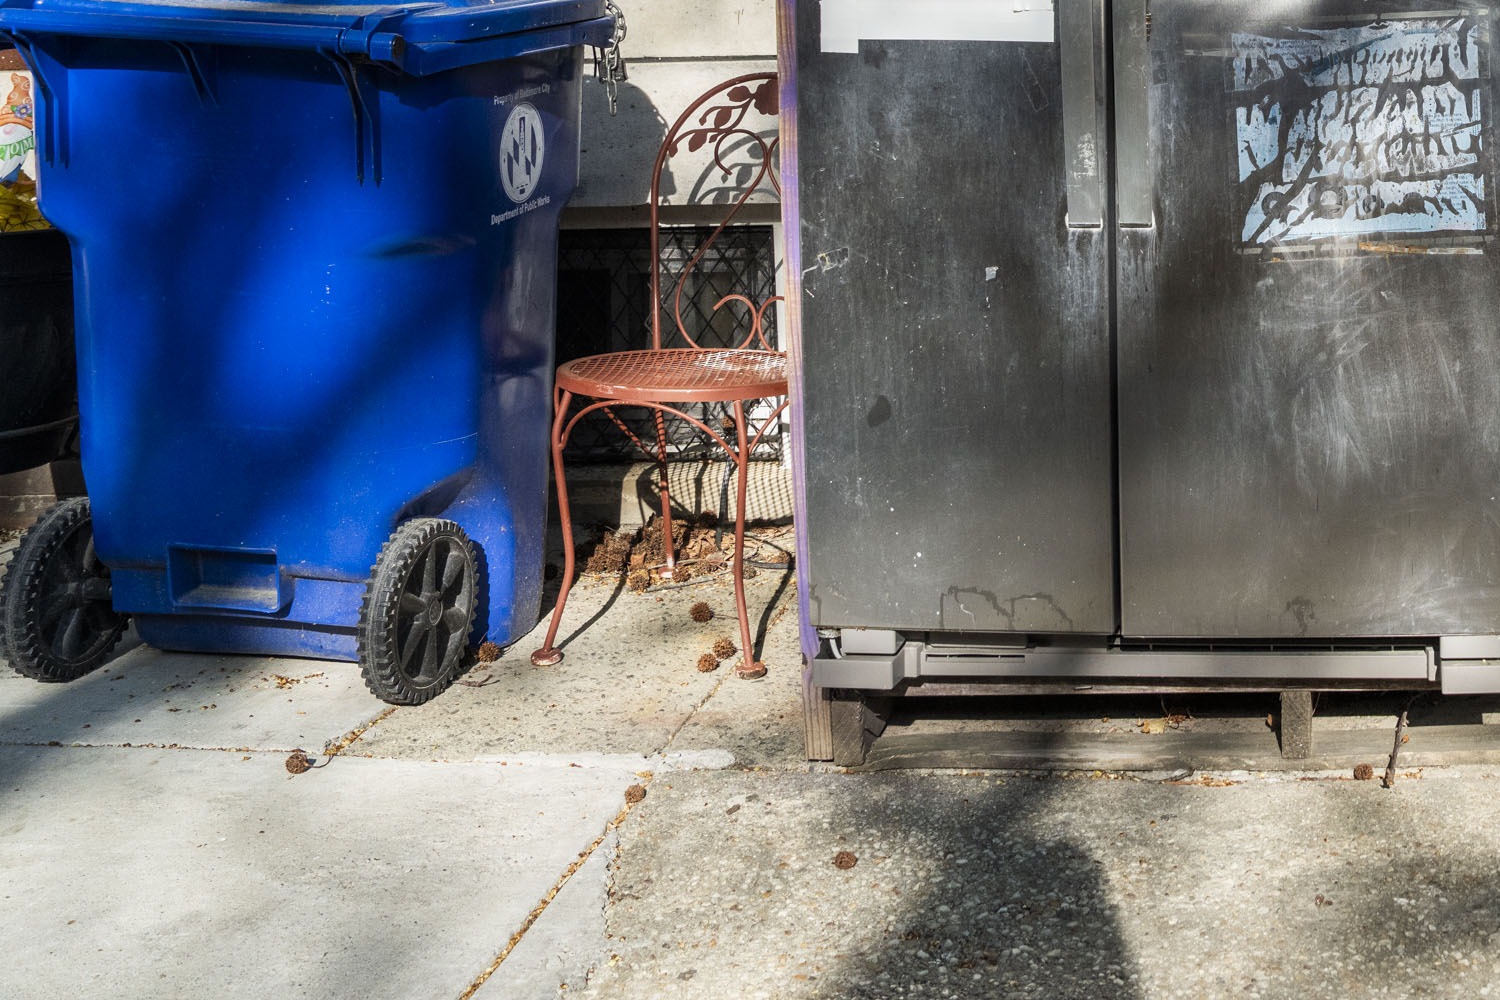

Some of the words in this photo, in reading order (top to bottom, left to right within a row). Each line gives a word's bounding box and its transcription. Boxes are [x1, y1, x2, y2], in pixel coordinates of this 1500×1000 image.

[491, 208, 519, 225] Department
[524, 201, 537, 212] Public
[538, 195, 550, 208] Works
